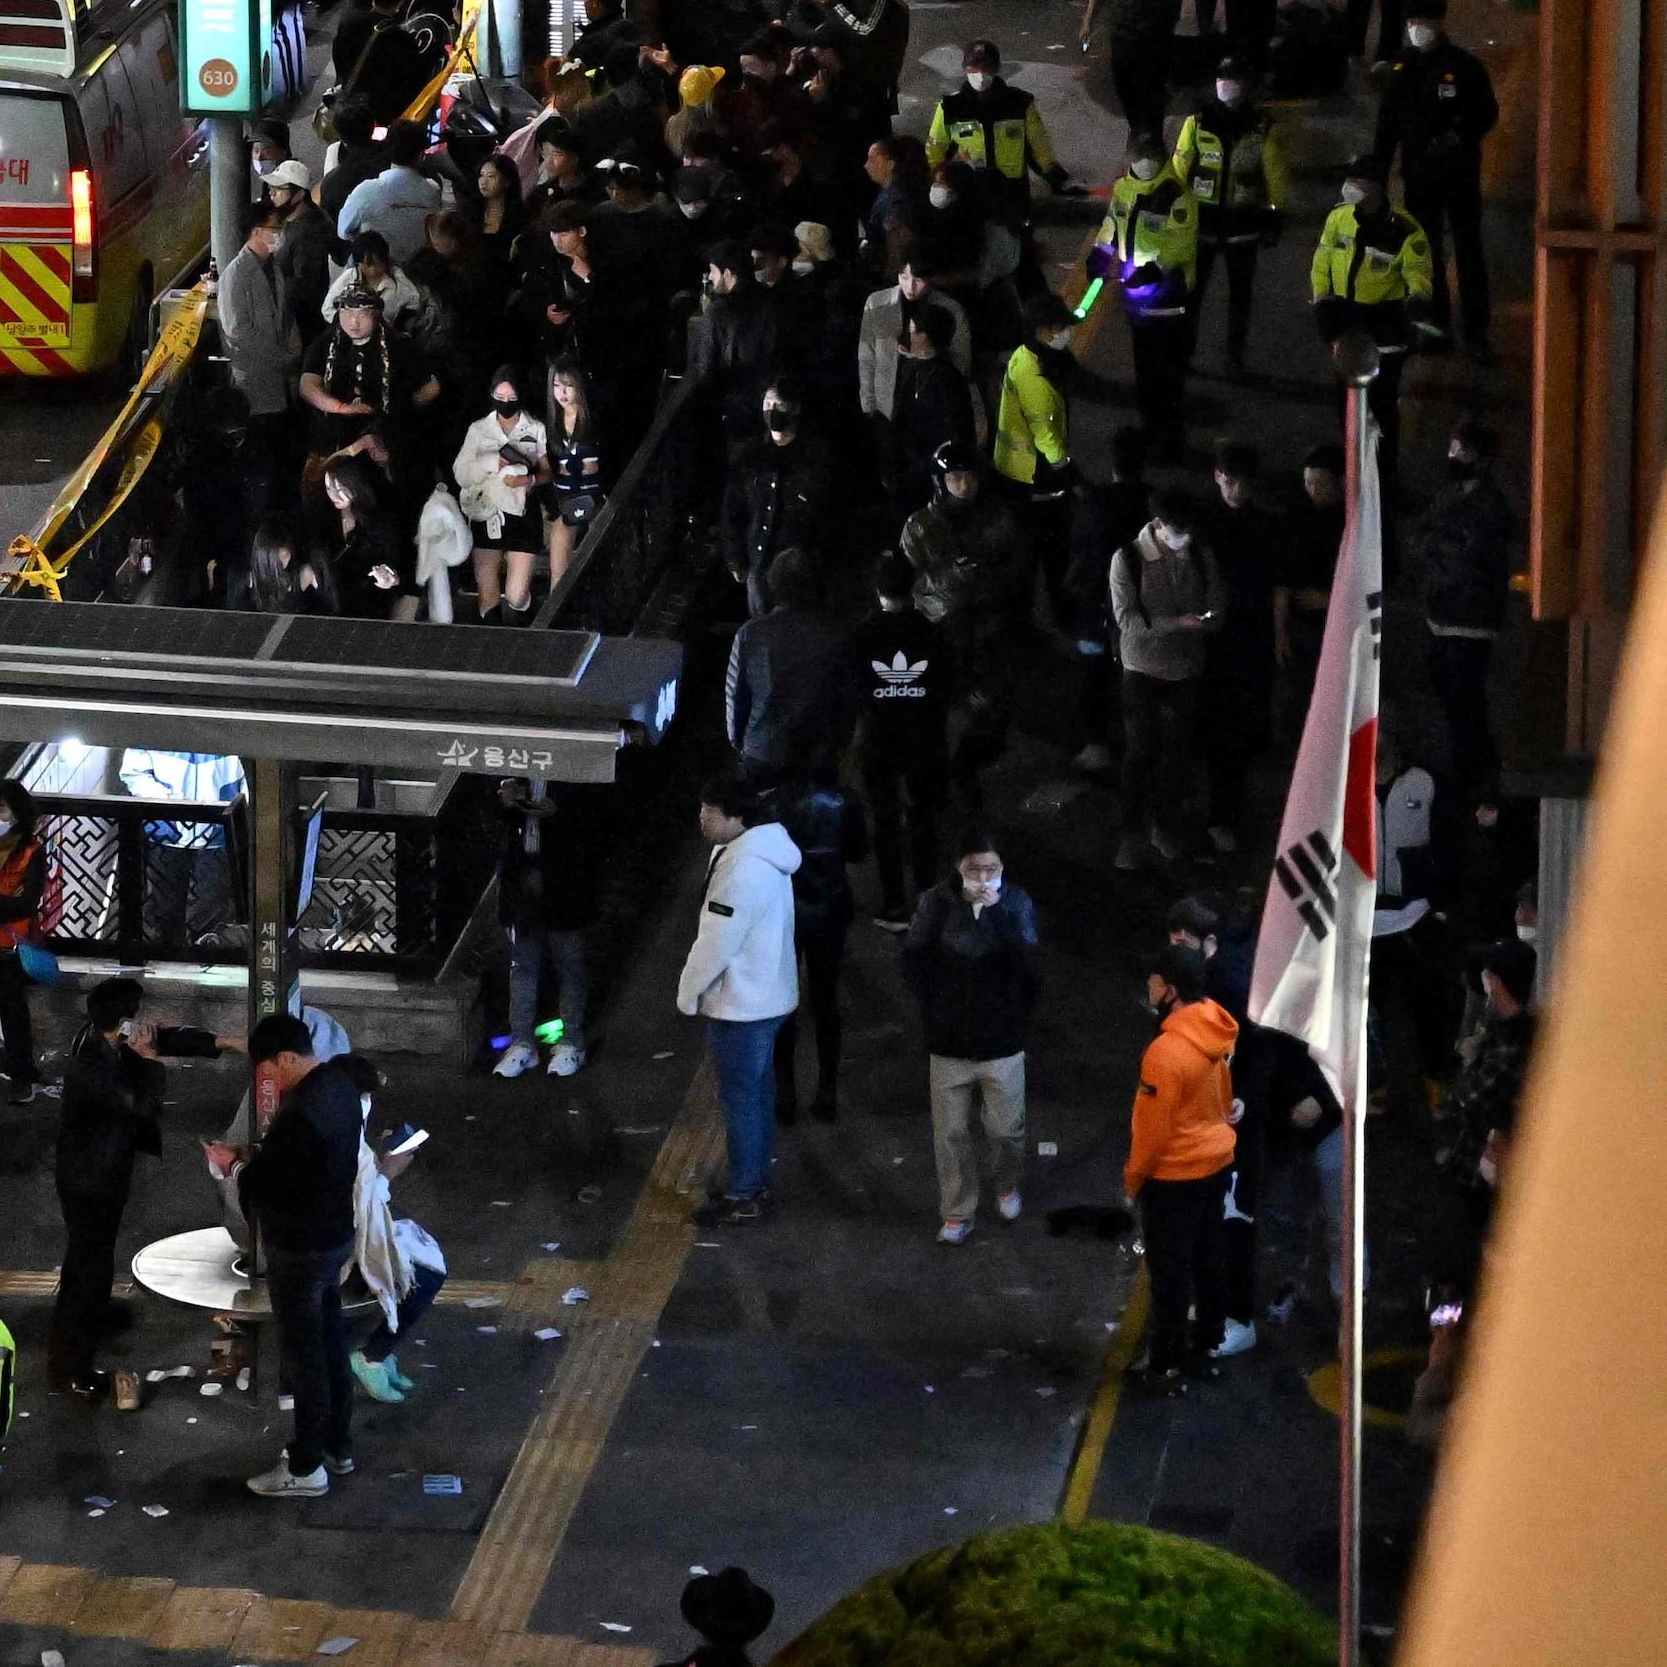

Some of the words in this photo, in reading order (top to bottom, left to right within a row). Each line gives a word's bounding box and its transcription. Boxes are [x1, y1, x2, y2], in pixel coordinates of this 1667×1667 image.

[203, 71, 234, 86] 630
[873, 683, 926, 699] adidas
[483, 745, 553, 771] 용산구
